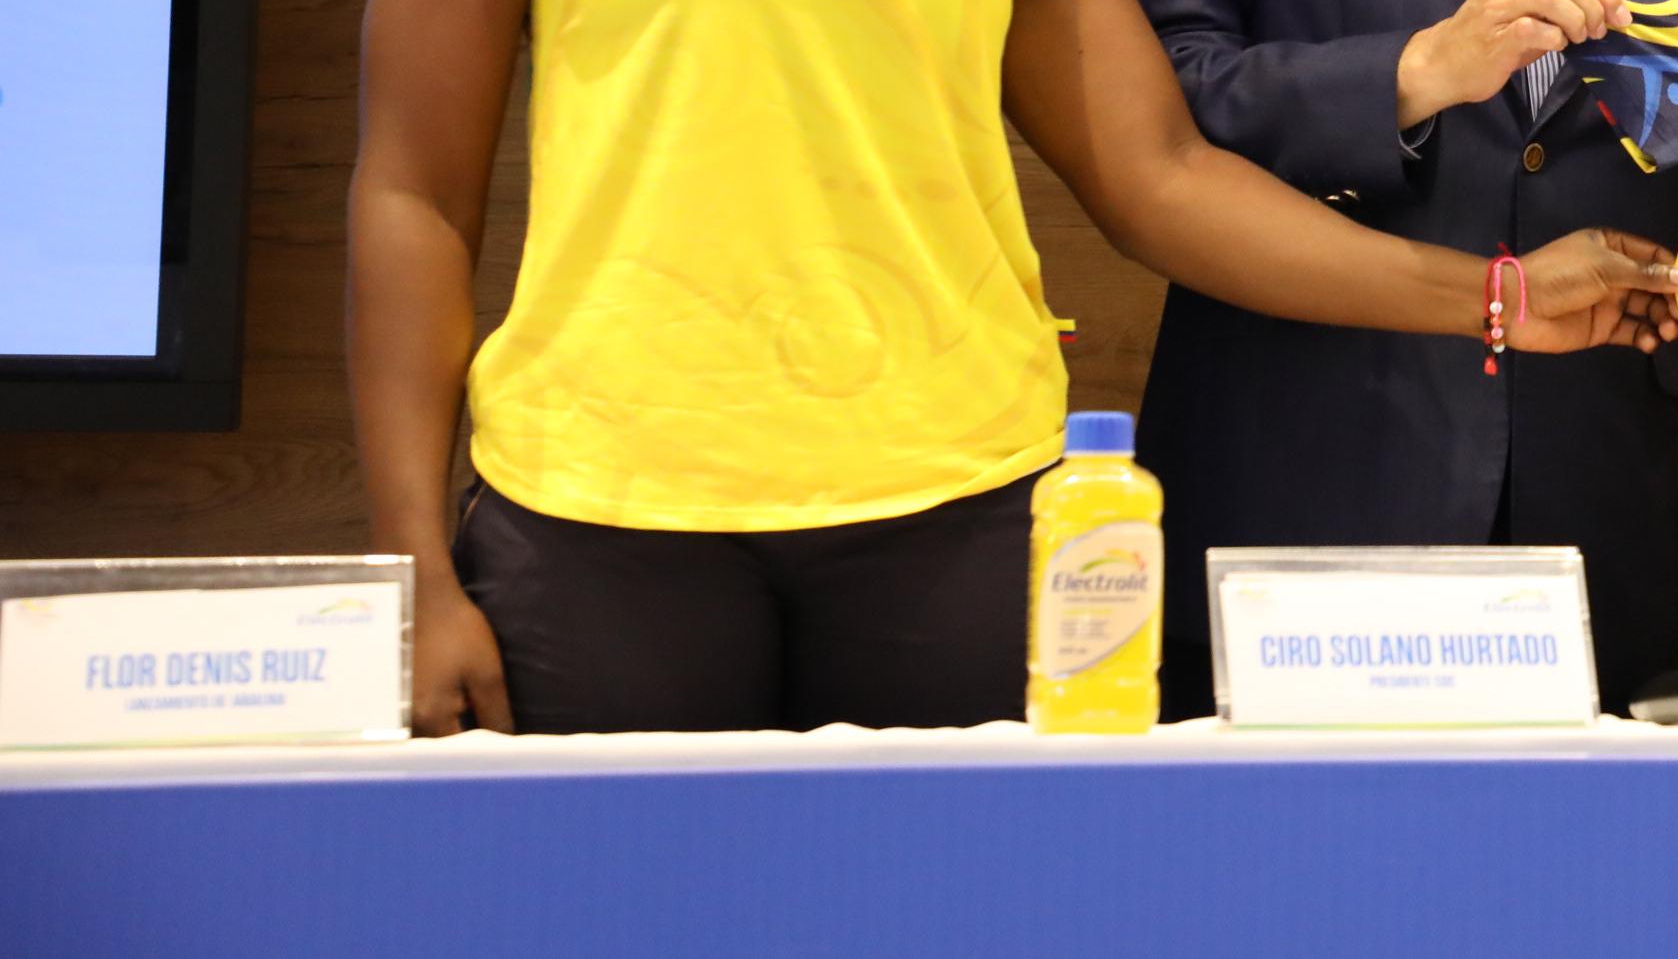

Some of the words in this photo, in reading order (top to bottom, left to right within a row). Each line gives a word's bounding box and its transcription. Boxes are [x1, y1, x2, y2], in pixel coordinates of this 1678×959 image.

[1052, 571, 1149, 593] Electrolit
[1260, 635, 1322, 667] CIRO
[1331, 634, 1433, 667] SOLANO
[1440, 633, 1559, 666] HURTADO
[85, 653, 156, 690] FLOR
[166, 650, 253, 688] DENIS
[260, 647, 328, 684] RUIZ
